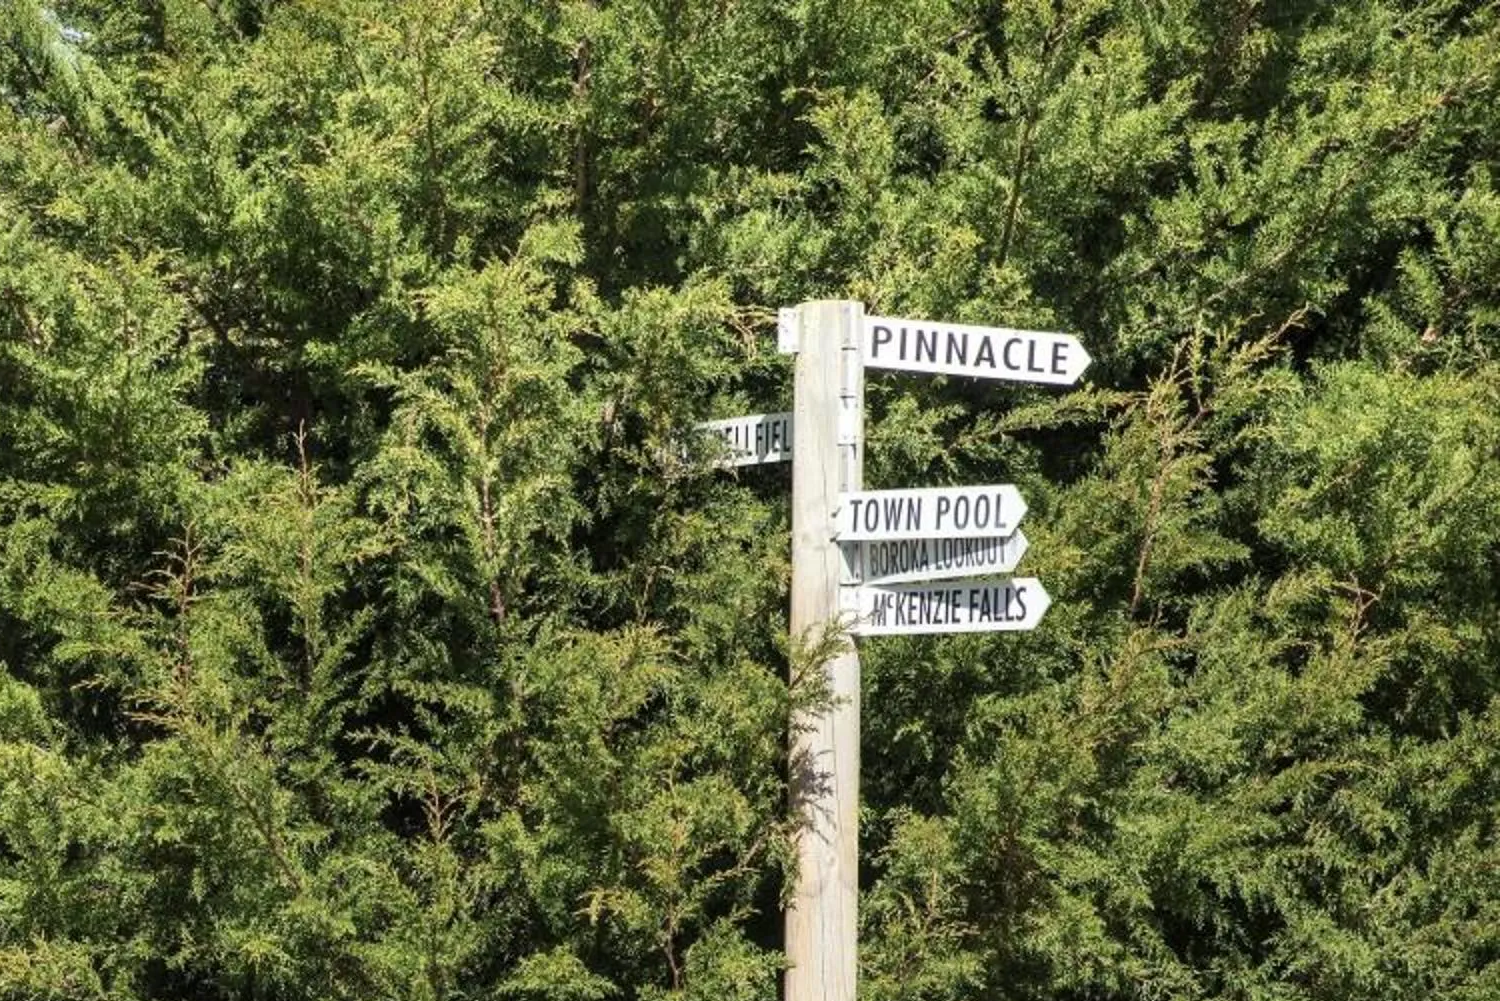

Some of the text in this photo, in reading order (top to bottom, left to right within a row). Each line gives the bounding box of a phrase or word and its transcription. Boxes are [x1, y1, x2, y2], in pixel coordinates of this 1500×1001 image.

[871, 325, 1069, 375] PINNACLE
[850, 494, 1007, 532] TOWN POOL
[870, 536, 1005, 576] BOROKA LOOKOUT
[969, 587, 1027, 623] FALLS
